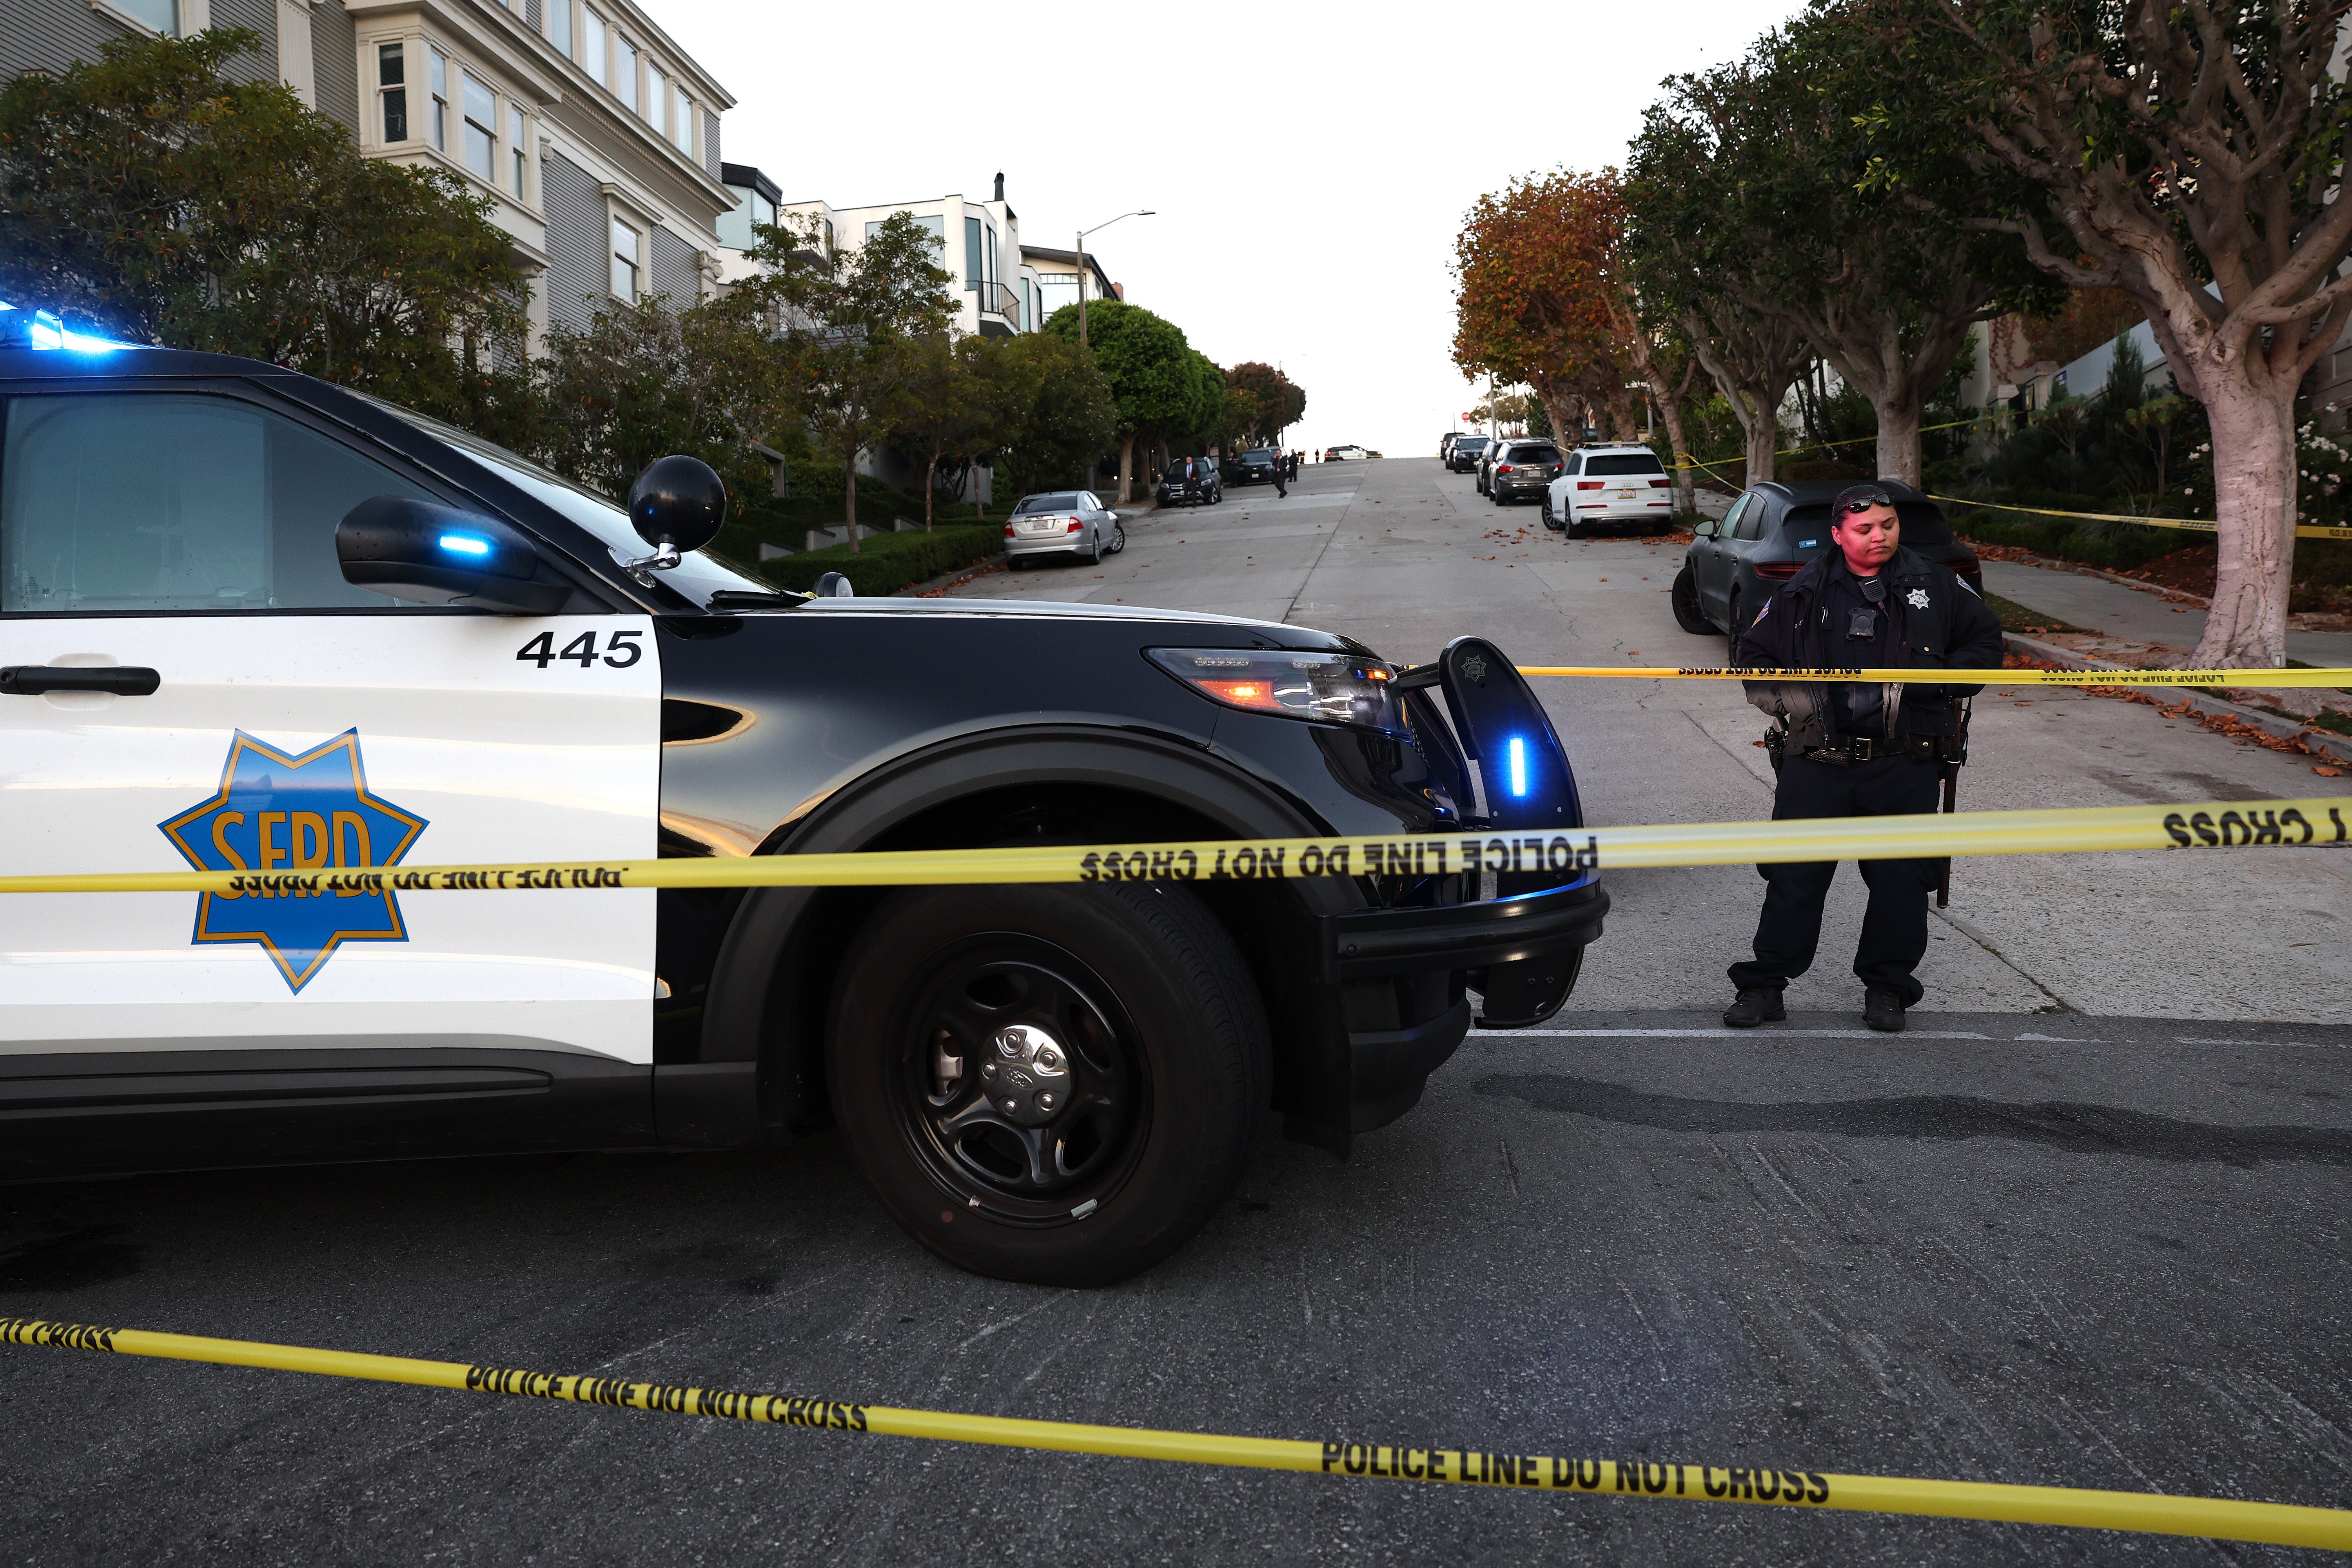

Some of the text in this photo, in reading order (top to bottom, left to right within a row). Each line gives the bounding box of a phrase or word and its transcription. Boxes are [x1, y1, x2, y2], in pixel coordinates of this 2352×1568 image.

[516, 631, 642, 668] 445
[2163, 809, 2314, 848] CROSS
[1080, 836, 1597, 882] POLICE LINE DO NOT CROSS
[32, 1322, 119, 1352] CROSS
[466, 1366, 868, 1431] POLICE LINE DO NOT CROSS
[1322, 1442, 1829, 1503] POLICE LINE DO NOT CROSS
